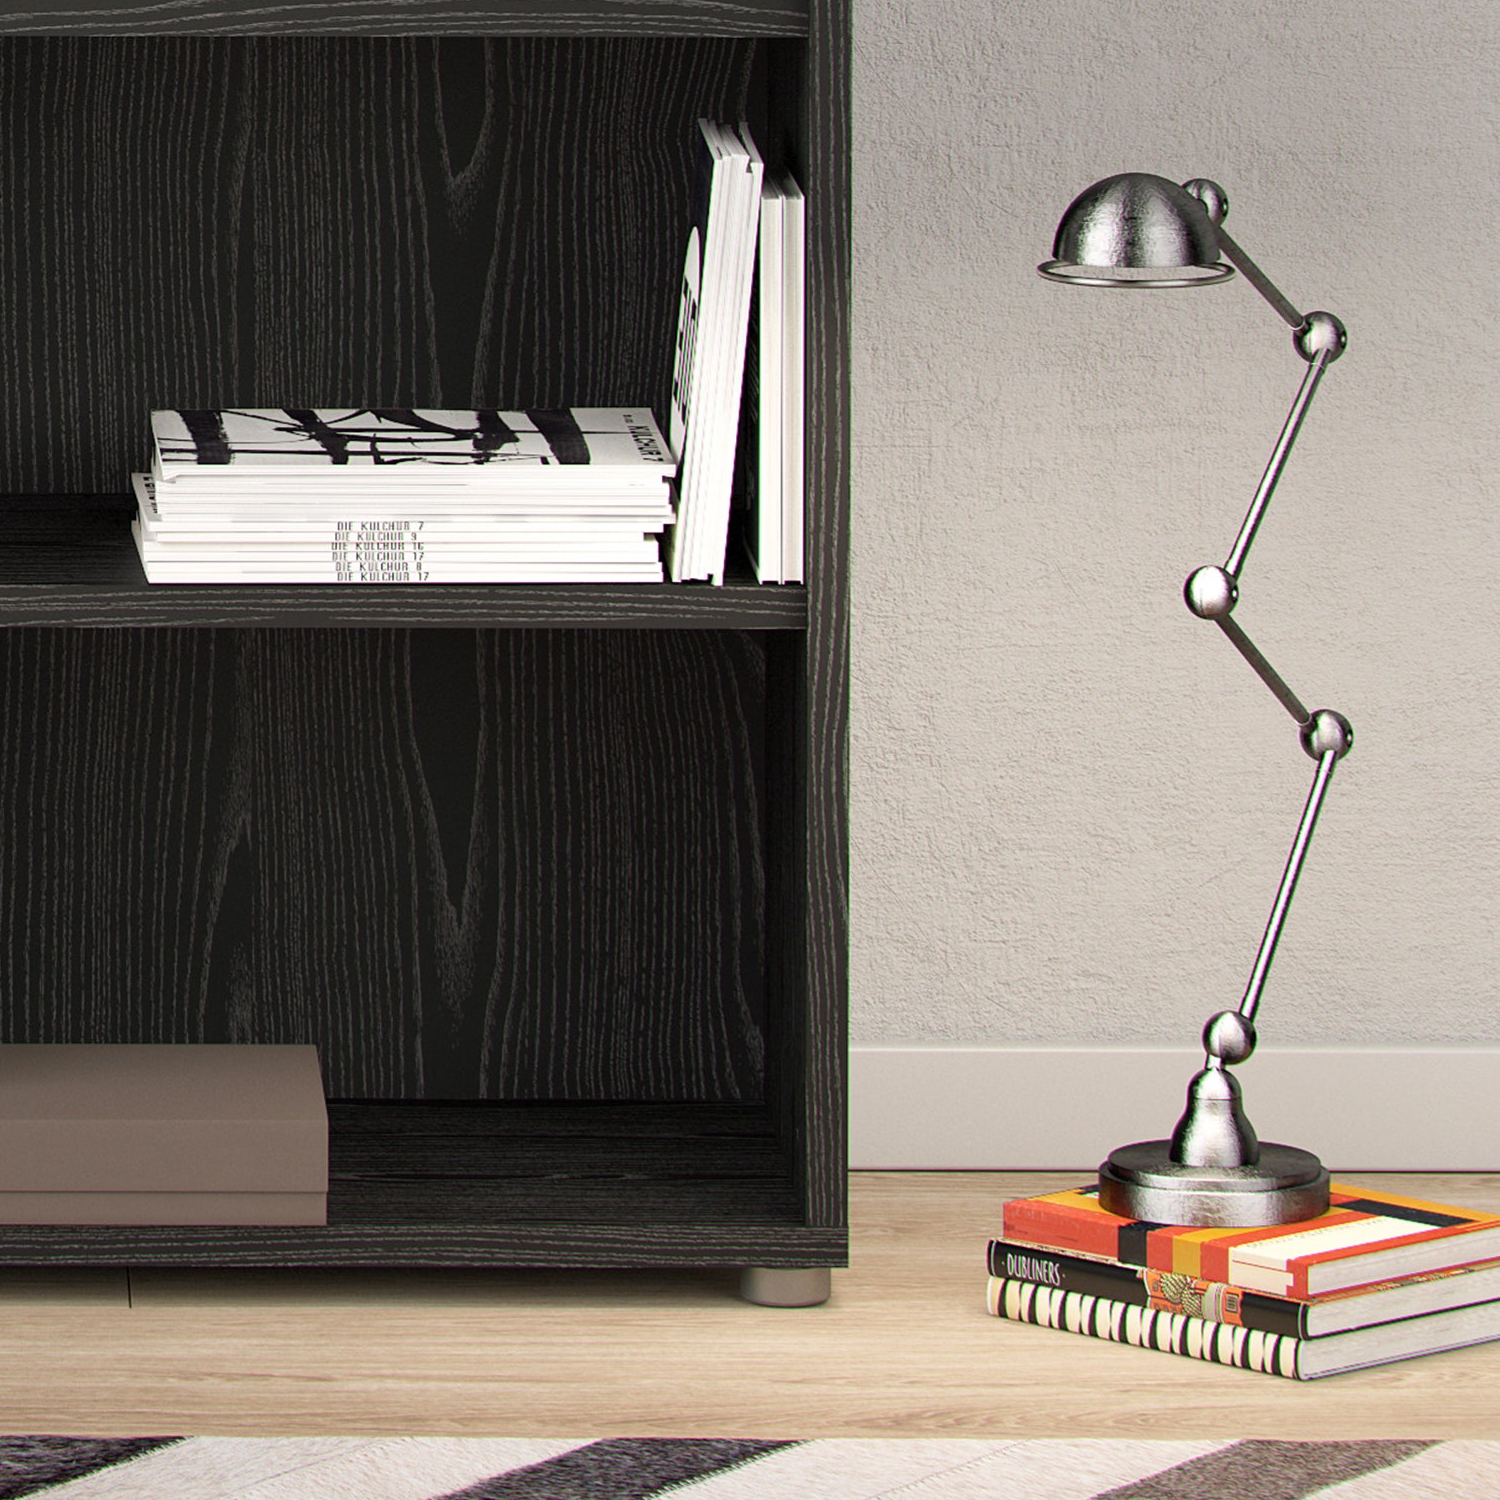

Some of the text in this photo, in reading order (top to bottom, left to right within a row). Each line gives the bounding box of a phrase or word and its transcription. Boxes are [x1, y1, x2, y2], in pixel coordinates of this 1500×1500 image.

[337, 521, 424, 531] DIE KULCHUR 7
[335, 532, 349, 541] DIE
[357, 532, 404, 541] KULCHUR
[332, 542, 347, 550] DIE
[332, 552, 424, 561] DIE KULCHUR 17
[335, 562, 352, 571] DIE
[359, 562, 408, 571] KULCHUR
[337, 572, 429, 581] DIE KULCHUR 17
[1006, 1253, 1061, 1287] DUBLINERS
